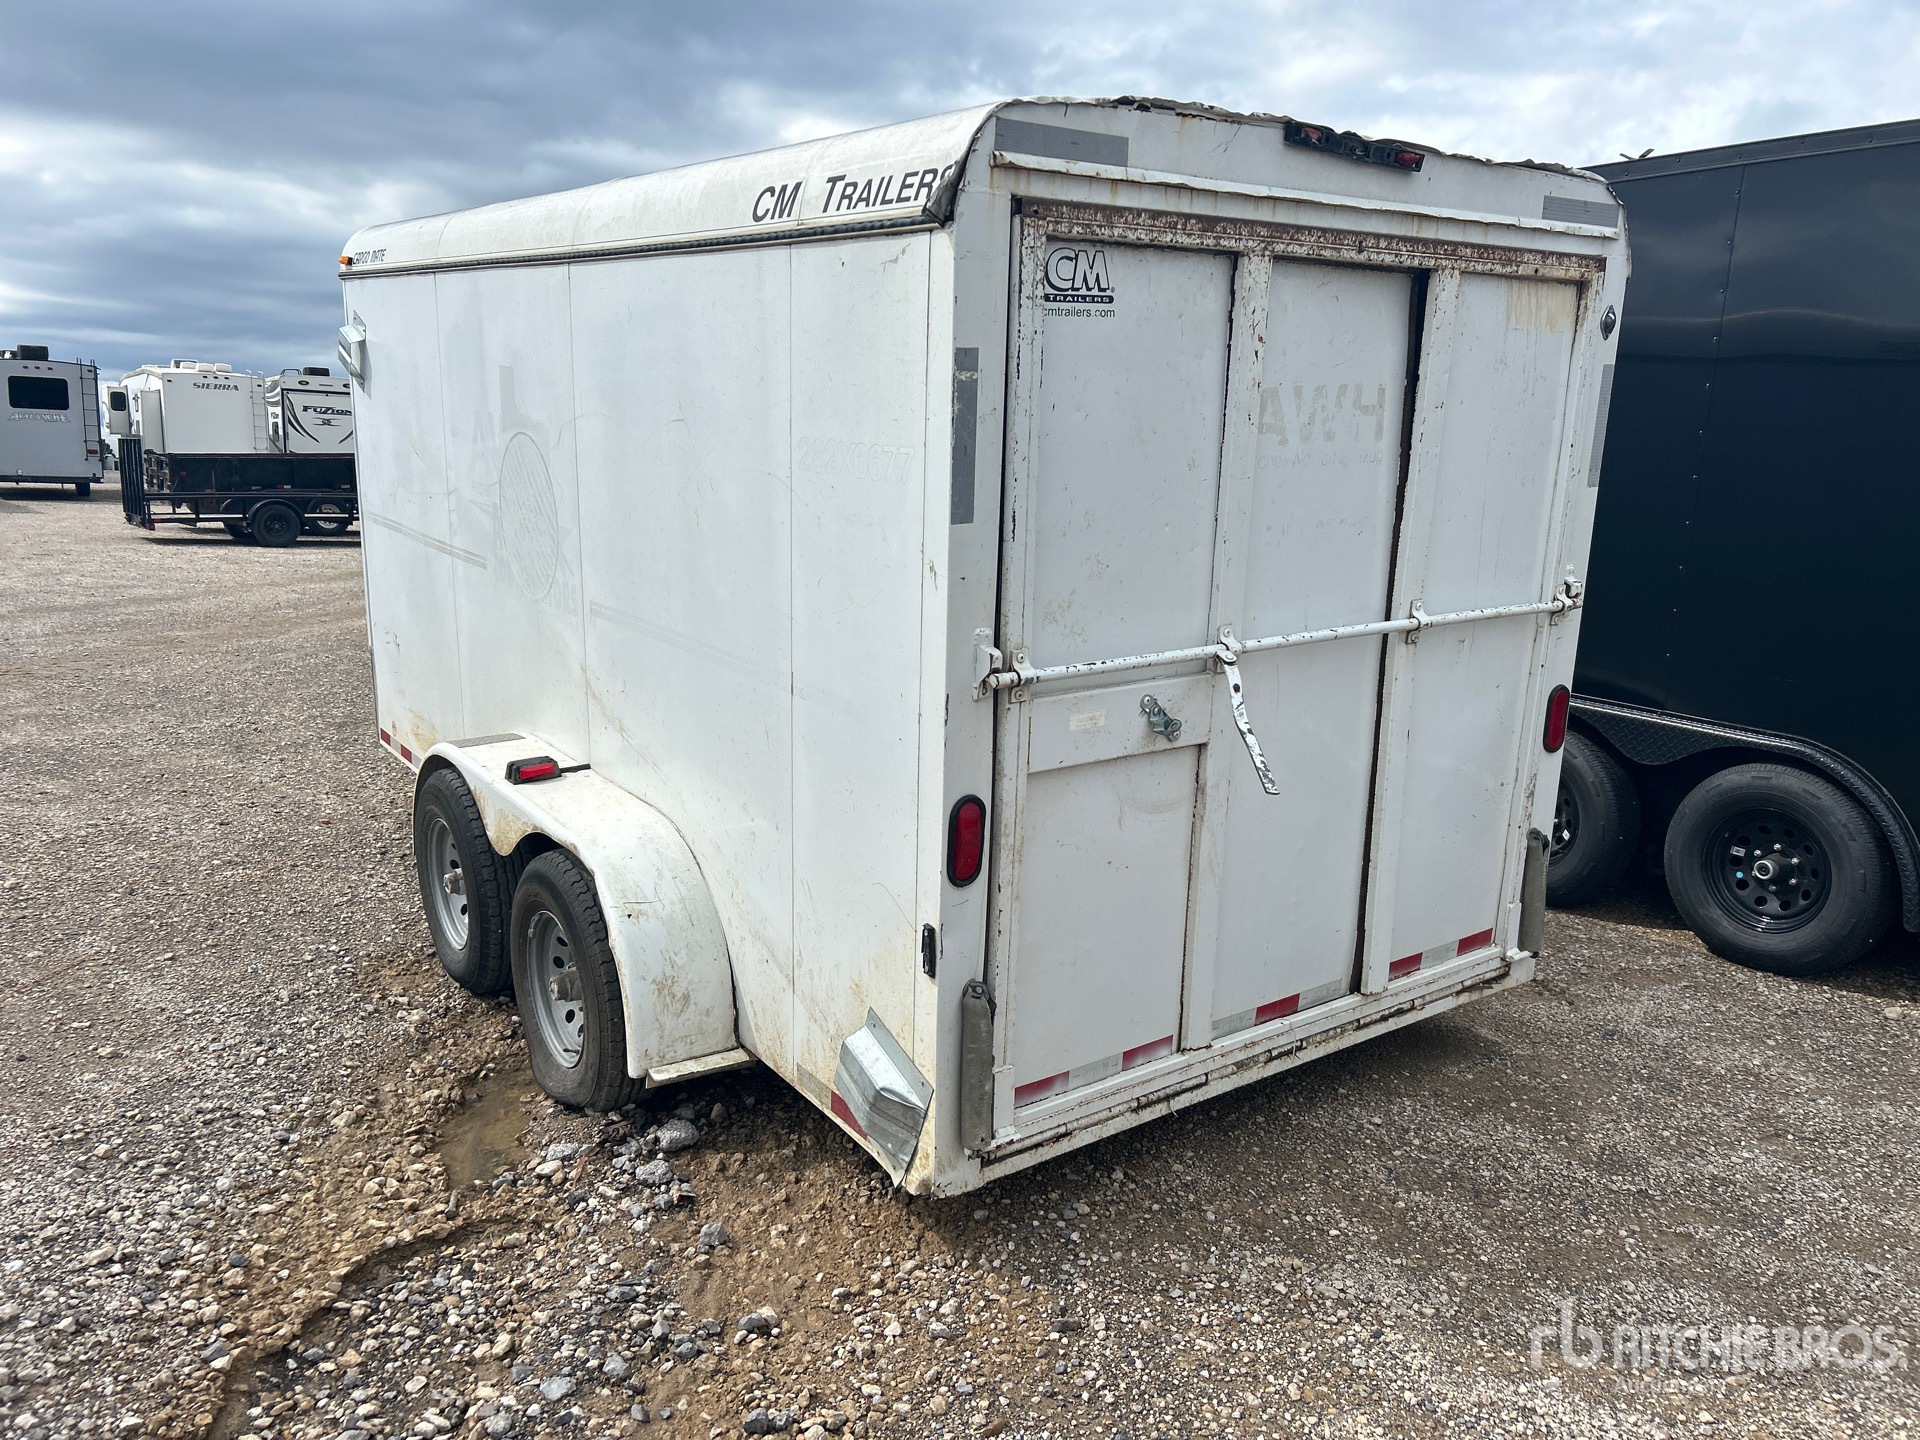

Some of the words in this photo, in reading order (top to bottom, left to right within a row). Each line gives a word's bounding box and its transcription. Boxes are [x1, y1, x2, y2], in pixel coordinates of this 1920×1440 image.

[752, 181, 803, 223] CM
[1045, 246, 1110, 293] CM
[1047, 294, 1110, 303] TRAILERS
[192, 381, 240, 392] SIERRA
